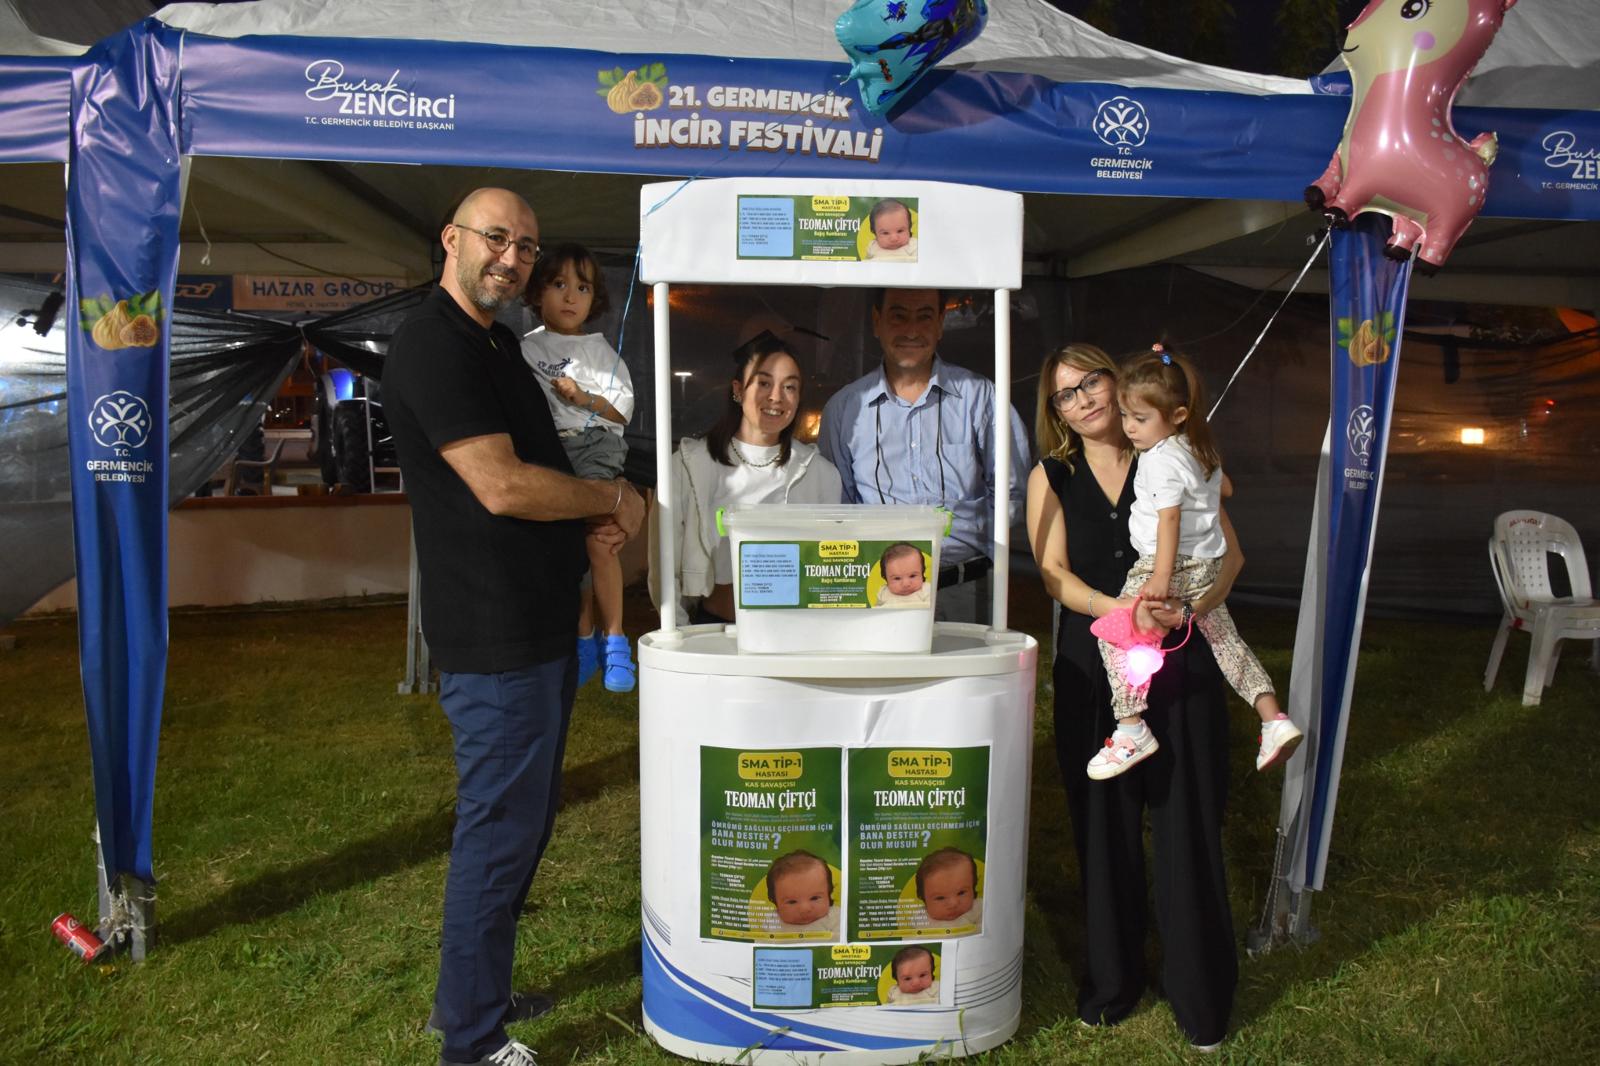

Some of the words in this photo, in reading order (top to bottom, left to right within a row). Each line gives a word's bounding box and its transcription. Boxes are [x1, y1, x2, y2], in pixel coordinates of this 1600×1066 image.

[305, 59, 408, 101] Burak
[335, 92, 455, 119] ZENCİRCİ
[669, 85, 701, 108] 21.
[707, 86, 853, 120] GERMENCİK
[305, 116, 319, 125] T.C.
[321, 117, 371, 127] GERMENCİK
[373, 119, 414, 129] BELEDİYE
[416, 121, 455, 131] BAŞKANI
[634, 112, 722, 149] İNCİR
[729, 119, 883, 163] FESTİVALİ
[1118, 147, 1132, 155] T.C.
[1090, 157, 1153, 169] GERMENCİK
[1568, 160, 1600, 179] ZE
[1096, 170, 1143, 179] BELEDİYESİ
[1555, 182, 1598, 190] GERMENCİK
[799, 218, 833, 230] TEOMAN
[835, 217, 861, 232] ÇİFTÇİ
[253, 281, 315, 297] HAZAR
[323, 282, 394, 297] GROUP
[114, 448, 131, 457] T.C.
[86, 460, 153, 473] GERMENCİK
[95, 472, 145, 483] BELEDİYESİ
[804, 564, 841, 577] TEOMAN
[843, 563, 870, 578] ÇİFTÇİ
[742, 760, 769, 769] SMA
[774, 756, 801, 769] TİP-1
[891, 757, 919, 767] SMA
[922, 754, 951, 767] TİP-1
[725, 790, 775, 809] TEOMAN
[779, 788, 816, 811] ÇİFTÇİ
[874, 790, 924, 807] TEOMAN
[928, 787, 965, 808] ÇİFTÇİ
[711, 820, 742, 831] ÖMRÜMÜ
[744, 823, 776, 832] SAĞLIKLI
[860, 823, 892, 831] ÖMRÜMÜ
[894, 822, 925, 831] SAĞLIKLI
[711, 829, 734, 839] BANA
[737, 832, 770, 841] DESTEK
[711, 838, 734, 847] OLUR
[736, 840, 768, 850] MUSUN
[771, 832, 781, 850] ?
[860, 832, 884, 841] BANA
[886, 831, 919, 840] DESTEK
[860, 841, 883, 849] OLUR
[886, 840, 917, 849] MUSUN
[921, 830, 931, 848] ?
[817, 967, 853, 979] TEOMAN
[855, 965, 882, 979] ÇİFTÇİ
